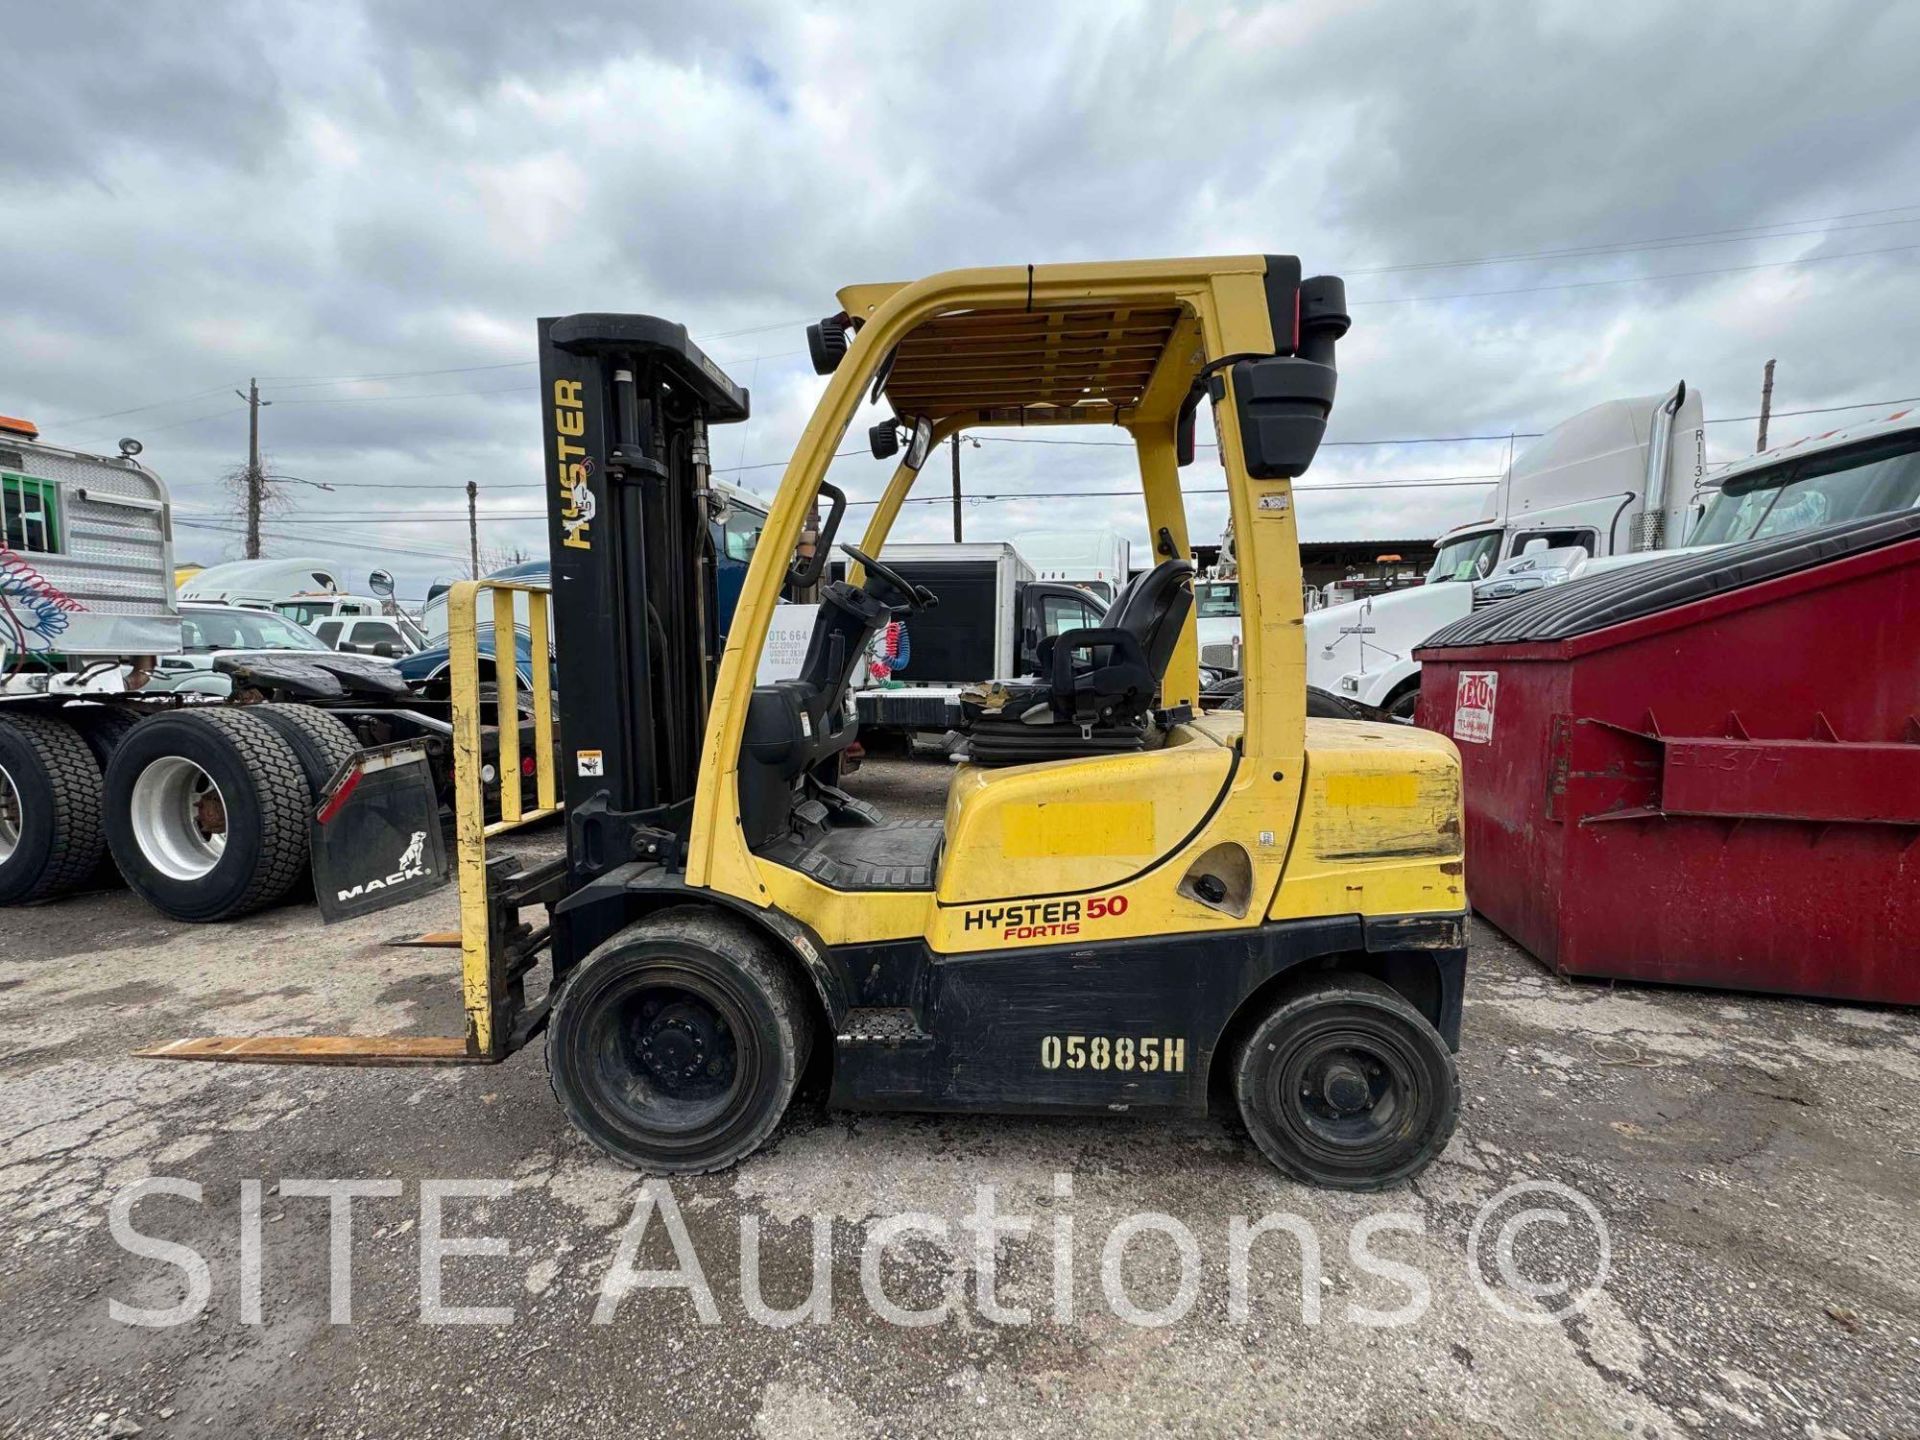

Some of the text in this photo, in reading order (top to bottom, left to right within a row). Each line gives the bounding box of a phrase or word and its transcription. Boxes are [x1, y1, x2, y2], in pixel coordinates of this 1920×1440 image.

[1457, 674, 1494, 714] NEXUS
[964, 895, 1128, 931] HYSTER 50
[1003, 922, 1080, 941] FORTIS
[1041, 1035, 1185, 1073] 05885H
